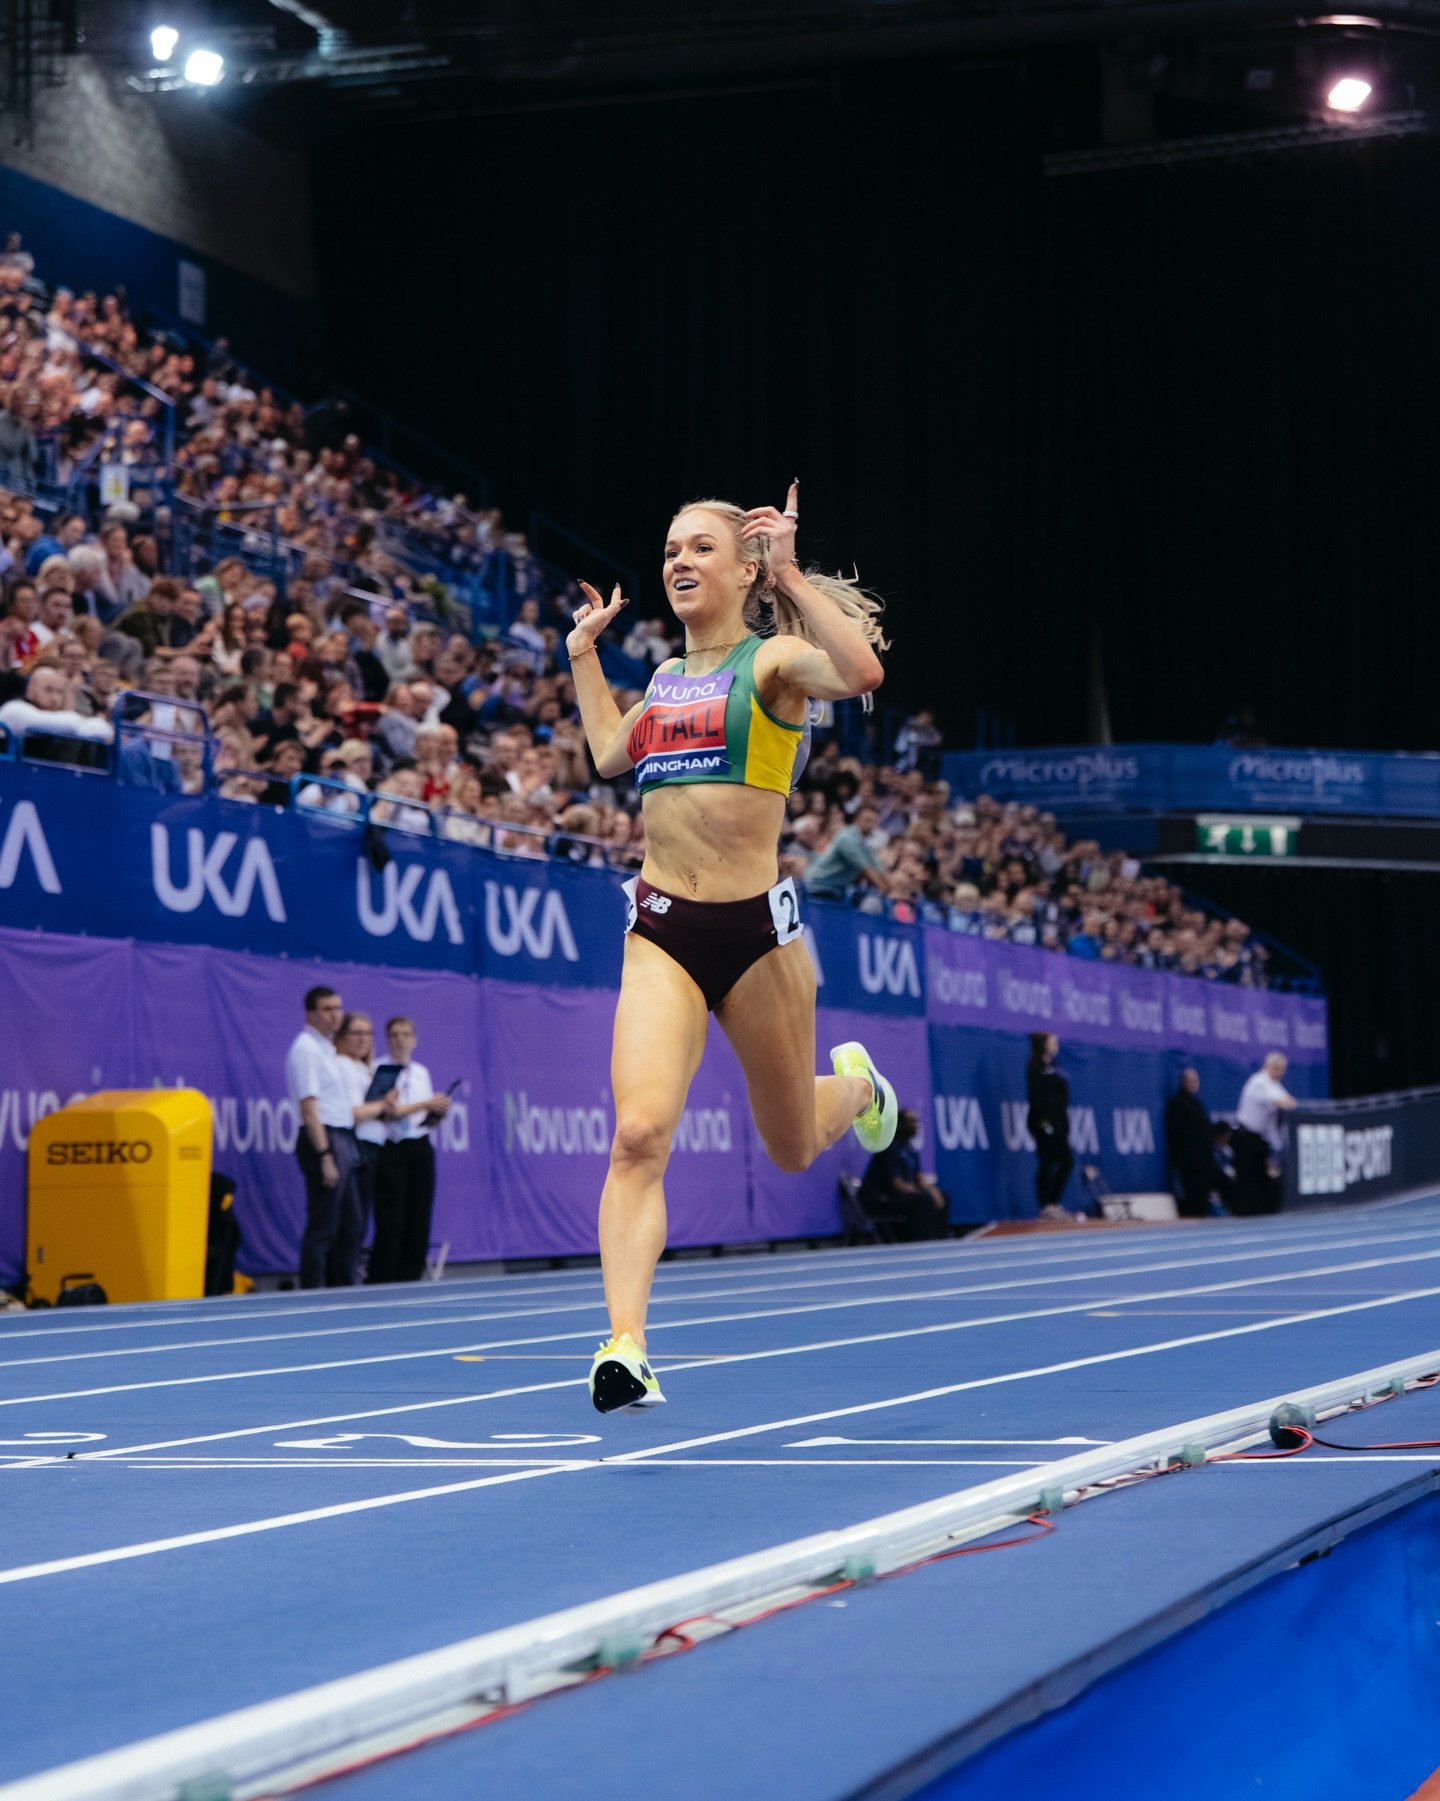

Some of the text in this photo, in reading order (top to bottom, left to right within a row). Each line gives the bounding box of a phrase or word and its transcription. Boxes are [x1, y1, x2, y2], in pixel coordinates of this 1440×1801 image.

[629, 707, 719, 754] NUTTALL
[151, 821, 287, 923] UKA
[357, 857, 465, 945] UKA
[484, 880, 580, 961] UKA
[780, 890, 799, 934] 2
[857, 932, 921, 999] UKA
[935, 1096, 989, 1151] UKA
[1001, 1101, 1037, 1152] UK
[47, 1141, 152, 1166] SEIKO
